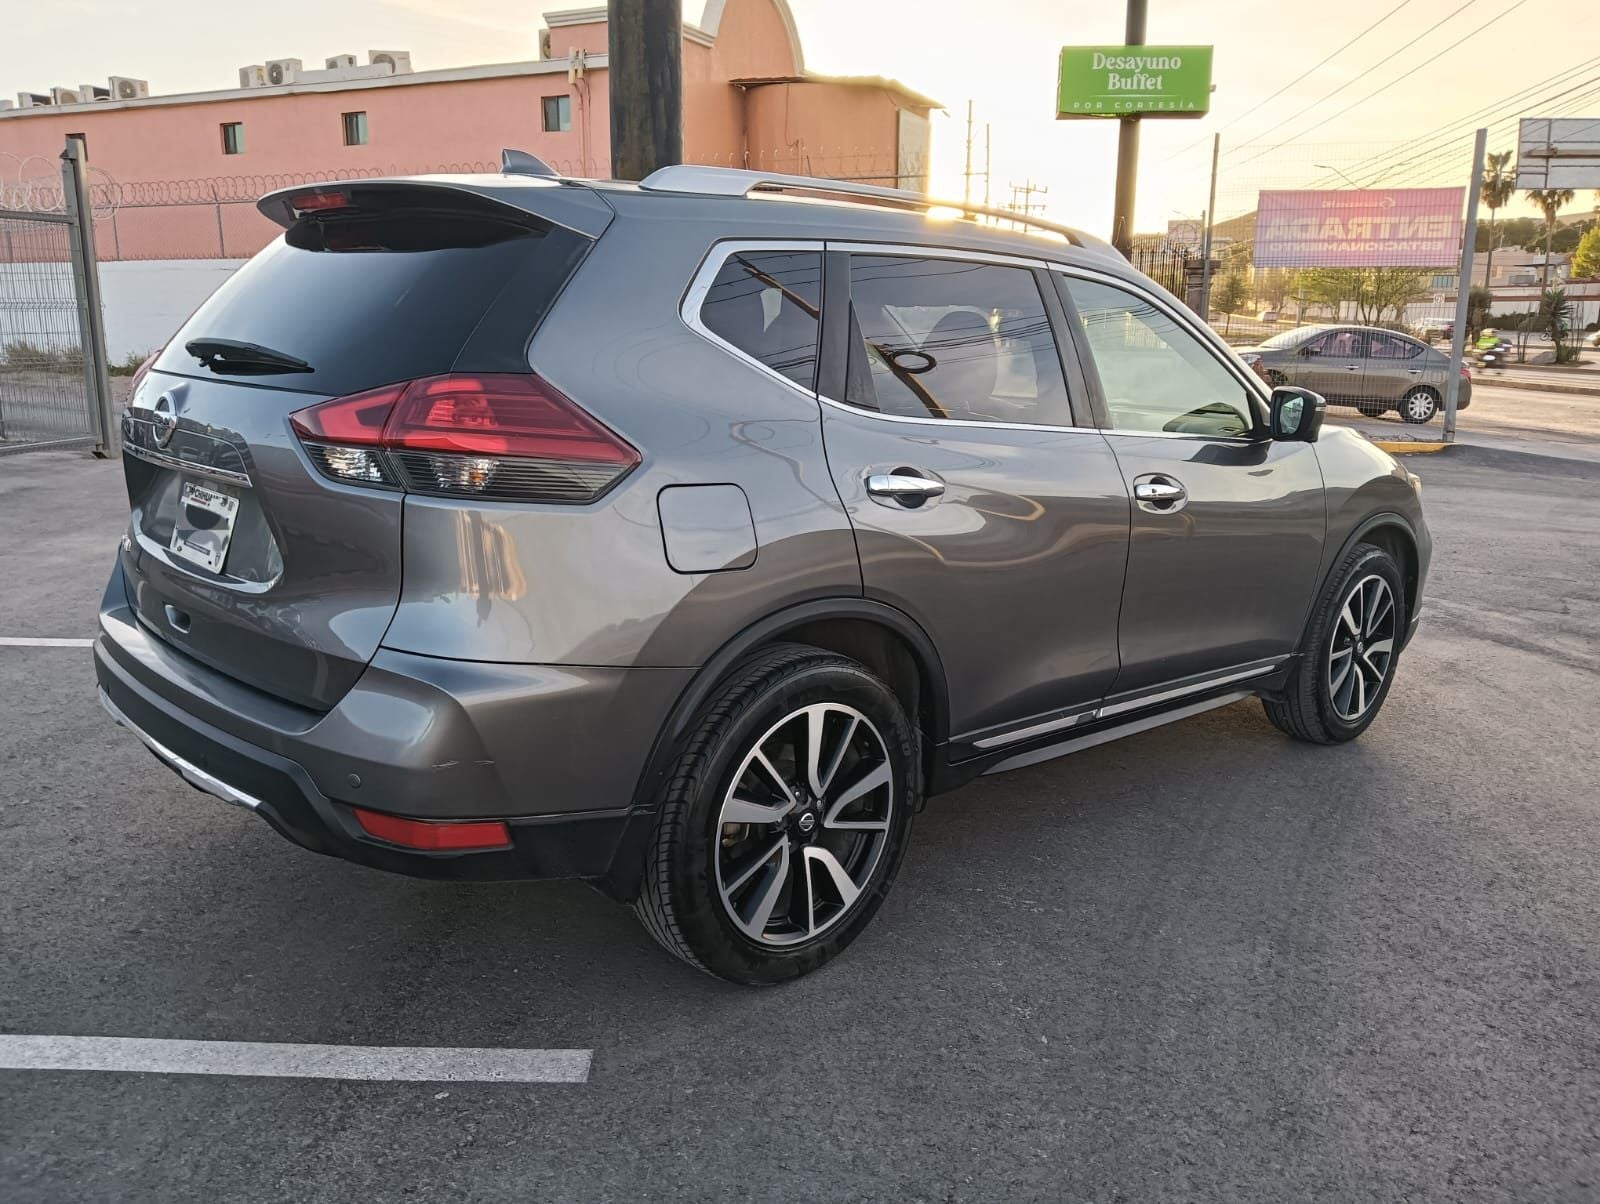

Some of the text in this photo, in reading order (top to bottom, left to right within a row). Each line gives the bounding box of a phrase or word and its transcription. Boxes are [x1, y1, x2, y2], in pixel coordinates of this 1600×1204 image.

[1092, 53, 1181, 72] Desayuno
[1107, 73, 1163, 90] Buffet
[1073, 100, 1195, 109] POR CORTESÍA
